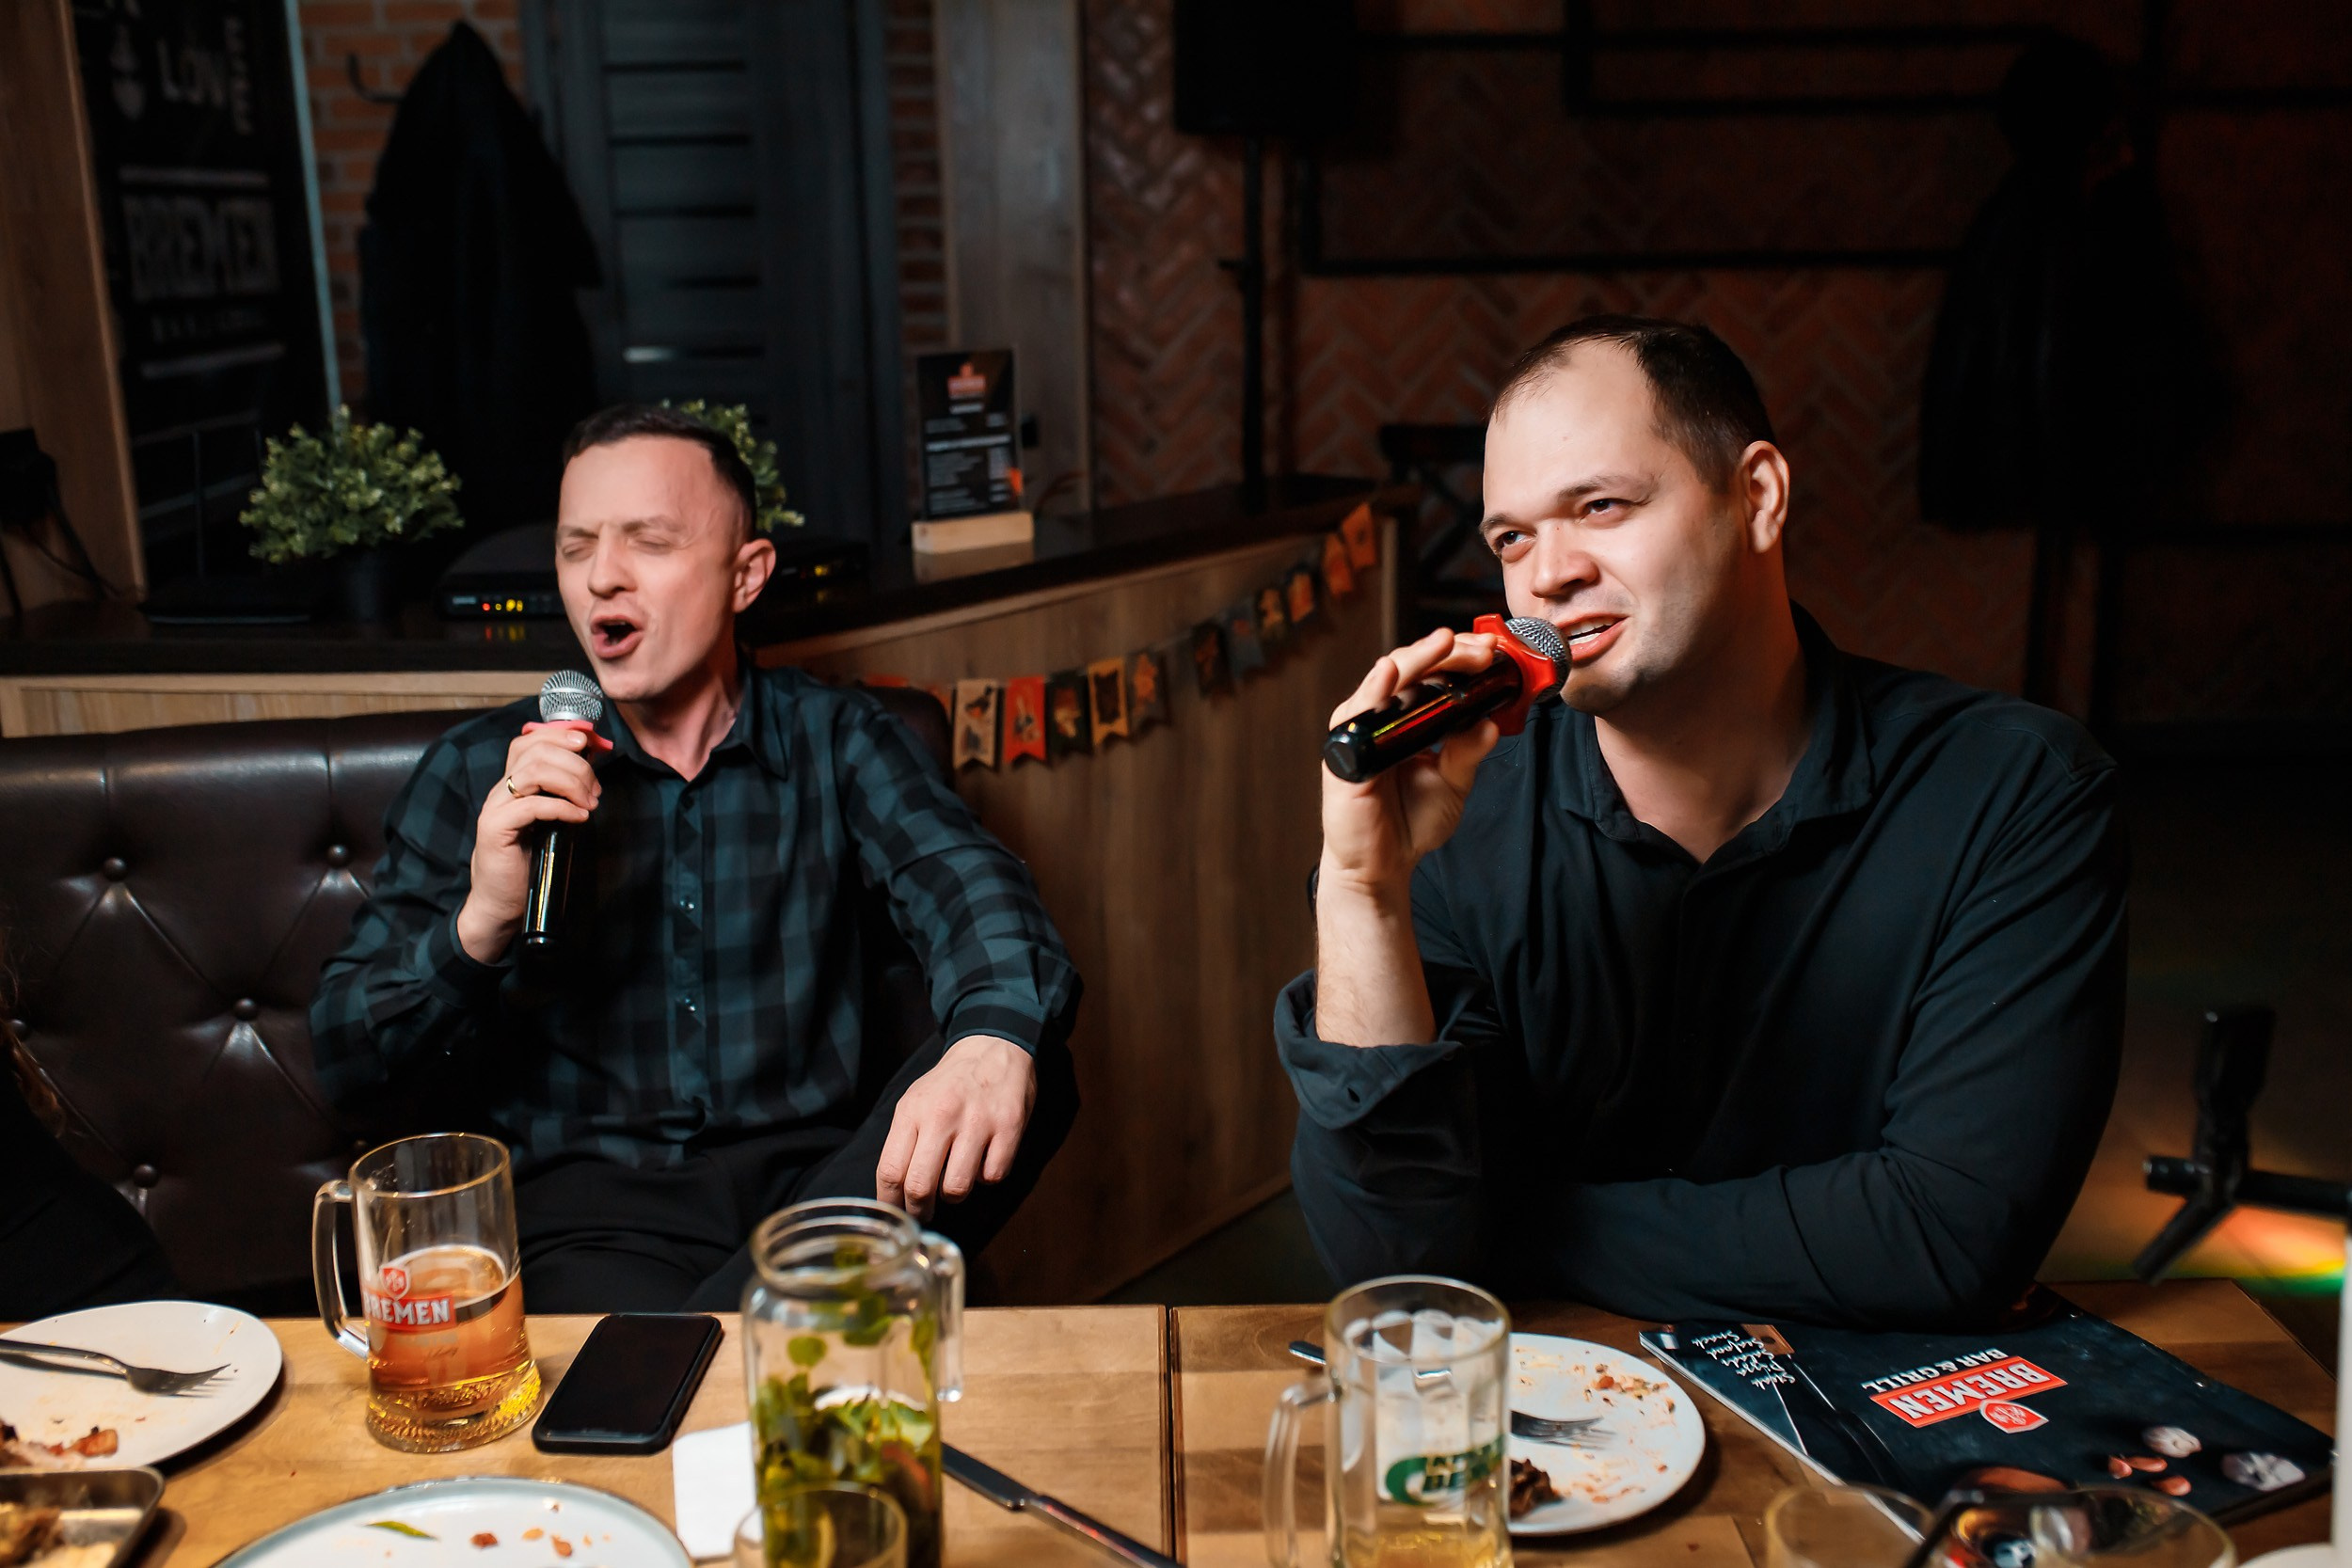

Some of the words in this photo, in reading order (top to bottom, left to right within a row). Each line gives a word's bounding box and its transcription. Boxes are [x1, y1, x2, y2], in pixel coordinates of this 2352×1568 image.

[1706, 1337, 1764, 1360] Seafood
[1955, 1347, 2010, 1368] BAR
[1736, 1359, 1786, 1377] Pizza
[1934, 1360, 1959, 1372] &
[1860, 1366, 1937, 1394] GRILL
[1888, 1362, 2052, 1419] BREMEN
